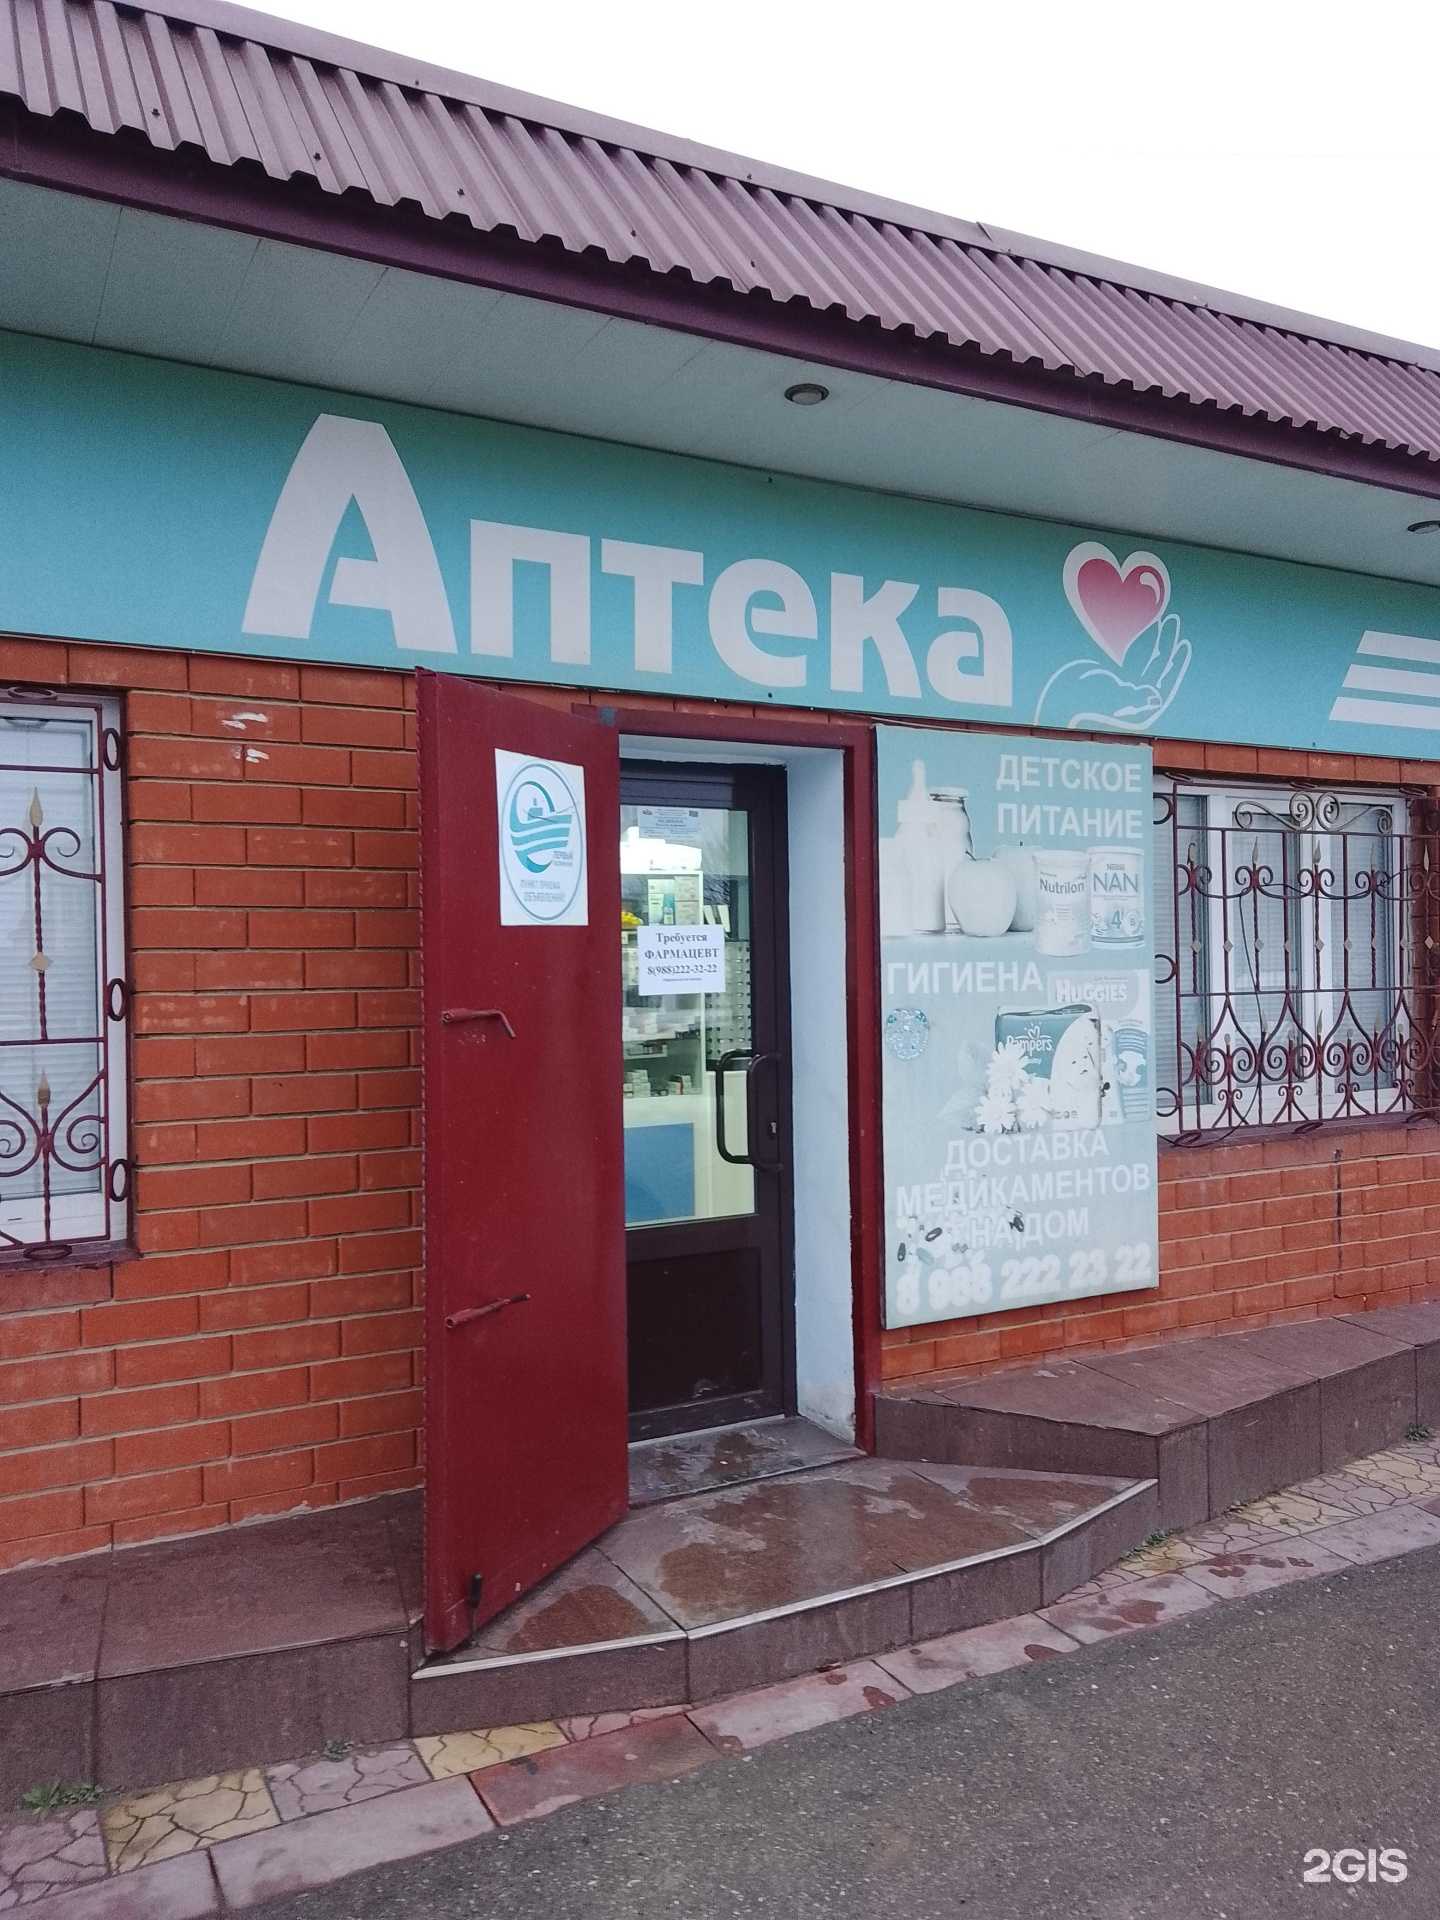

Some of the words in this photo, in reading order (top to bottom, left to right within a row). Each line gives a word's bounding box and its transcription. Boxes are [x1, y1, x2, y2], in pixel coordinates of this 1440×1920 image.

[242, 413, 1014, 707] Аптека
[996, 754, 1143, 793] ДЕТСКОЕ
[997, 803, 1144, 839] ПИТАНИЕ
[1040, 878, 1085, 894] Nutrilon
[1093, 872, 1139, 893] NAN
[644, 948, 720, 960] ФАРМАЦЕВТ
[656, 932, 708, 945] Требуется
[886, 961, 1044, 995] ГИГИЕНА
[1007, 1034, 1053, 1056] Pampers
[944, 1129, 1111, 1175] ДОСТАВКА
[896, 1163, 1150, 1216] МЕДИКАМЕНТОВ
[970, 1213, 1014, 1248] НА
[1021, 1207, 1089, 1246] ДОМ
